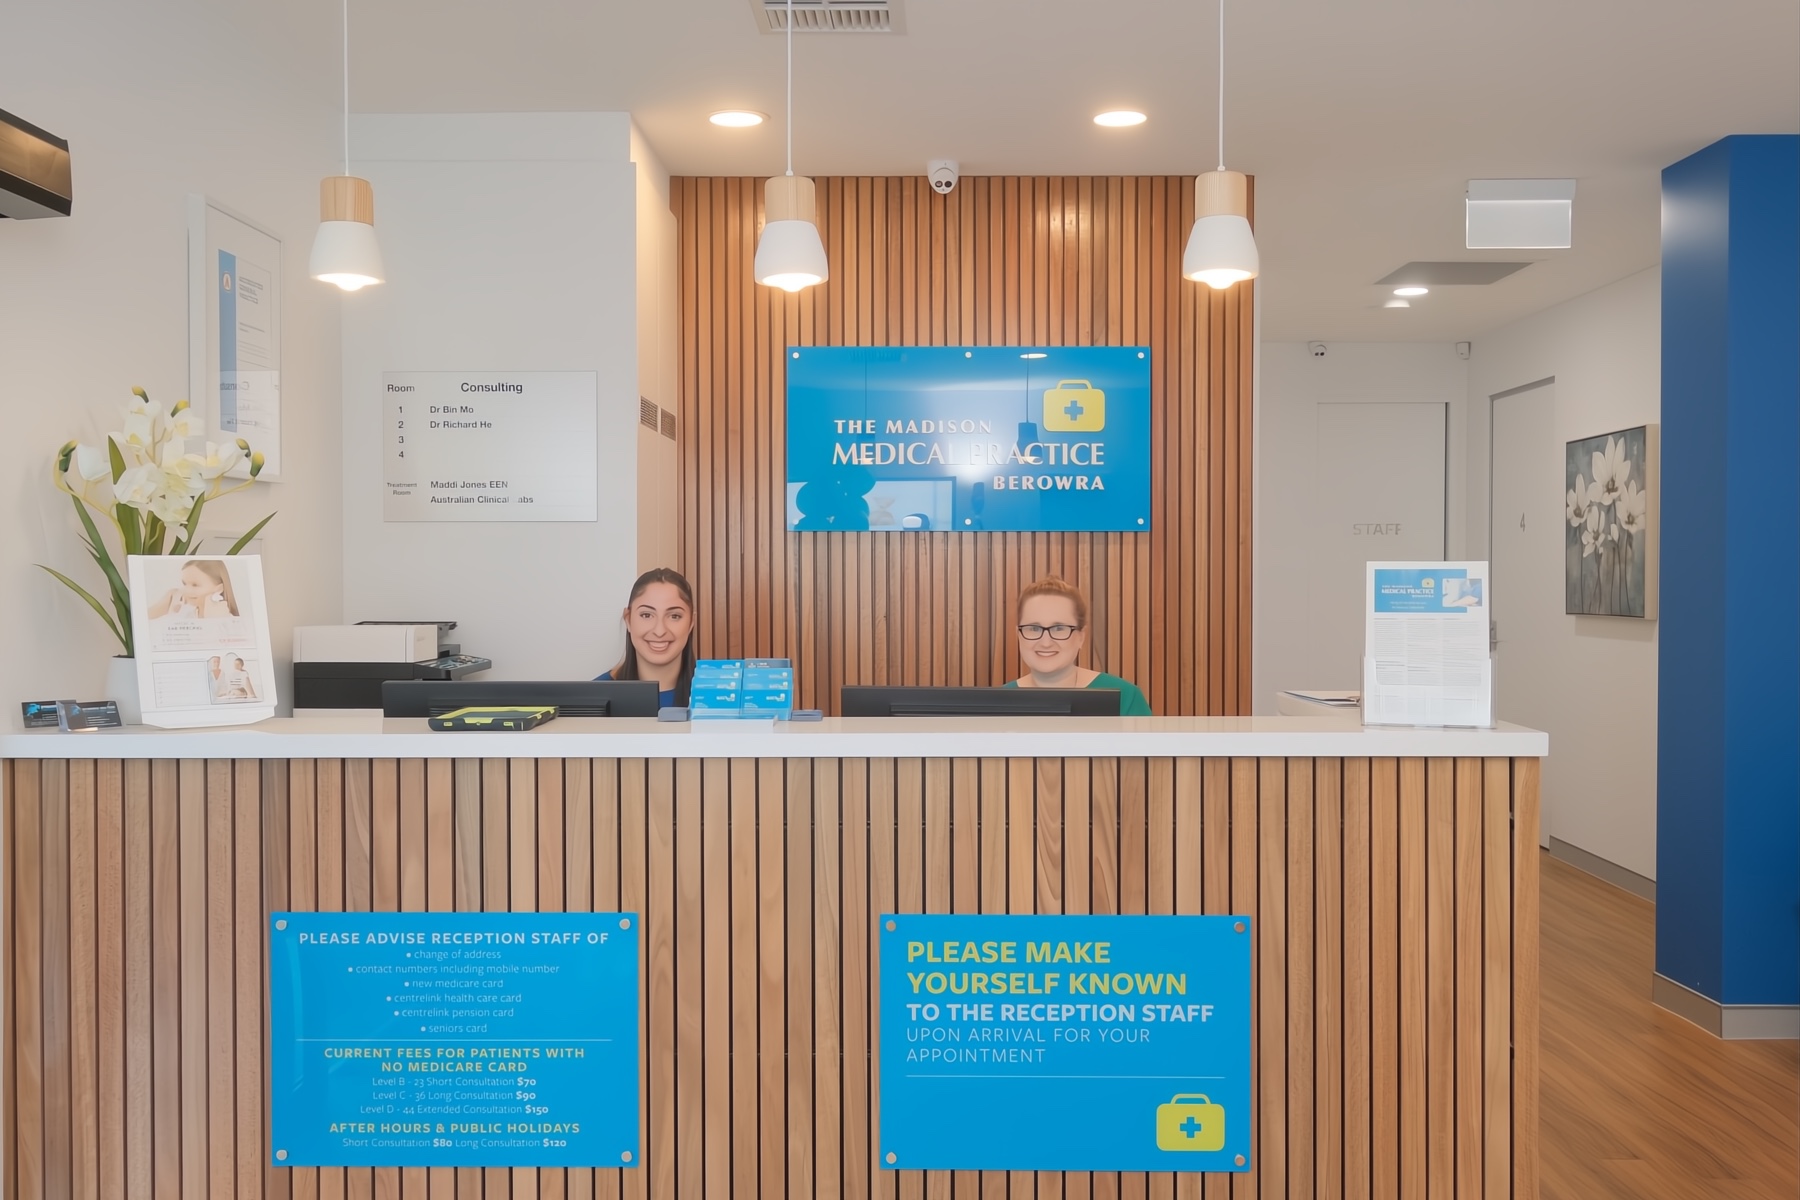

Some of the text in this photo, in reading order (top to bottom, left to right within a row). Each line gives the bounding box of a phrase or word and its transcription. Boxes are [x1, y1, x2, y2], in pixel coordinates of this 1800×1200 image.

[387, 383, 415, 393] Room
[460, 382, 523, 395] Consulting
[398, 405, 403, 414] 1
[429, 405, 474, 414] Dr Bin Mo
[397, 420, 404, 429] 2
[429, 420, 493, 429] Dr Richard He
[834, 419, 992, 434] THE MADISON
[397, 435, 405, 444] 3
[398, 450, 405, 459] 4
[832, 441, 1105, 465] MEDICAL PRACTICE
[430, 480, 508, 489] Maddi Jones EEN
[993, 475, 1105, 490] BEROWRA
[430, 495, 534, 504] Australian Clinical abs
[1519, 513, 1526, 532] 4
[1352, 523, 1402, 535] STAFF
[299, 932, 609, 945] PLEASE ADVISE RECEPTION STAFF OF
[413, 948, 502, 962] change of address
[907, 941, 1111, 964] PLEASE MAKE
[355, 963, 560, 977] contact numbers including mobile number
[412, 979, 504, 988] new medicare card
[906, 971, 1187, 995] YOURSELF KNOWN
[394, 993, 522, 1003] centrelink health care card
[401, 1007, 515, 1019] centrelink pension card
[906, 1003, 1214, 1023] TO THE RECEPTION STAFF
[428, 1023, 488, 1033] seniors card
[906, 1027, 1150, 1043] UPON ARRIVAL FOR YOUR
[324, 1047, 585, 1059] CURRENT FEES FOR PATIENTS WITH
[906, 1047, 1046, 1063] APPOINTMENT
[381, 1061, 528, 1073] NO MEDICARE CARD
[372, 1077, 396, 1086] Level
[398, 1077, 405, 1086] B
[413, 1078, 425, 1088] 23
[426, 1076, 452, 1086] Short
[455, 1076, 515, 1086] Consultation
[516, 1076, 537, 1088] $70
[372, 1091, 397, 1100] Level
[399, 1091, 406, 1100] C
[415, 1091, 426, 1102] 36
[428, 1091, 452, 1103] Long
[453, 1091, 514, 1100] Consultation
[515, 1090, 537, 1102] $90
[360, 1105, 385, 1114] Level
[387, 1105, 394, 1114] D
[402, 1106, 415, 1115] 44
[417, 1105, 461, 1114] Extended
[463, 1105, 523, 1114] Consultation
[524, 1103, 549, 1116] $150
[329, 1122, 580, 1134] AFTER HOURS & PUBLIC HOLIDAYS
[342, 1137, 567, 1150] Short Consultation $80 Long Consultation $120
